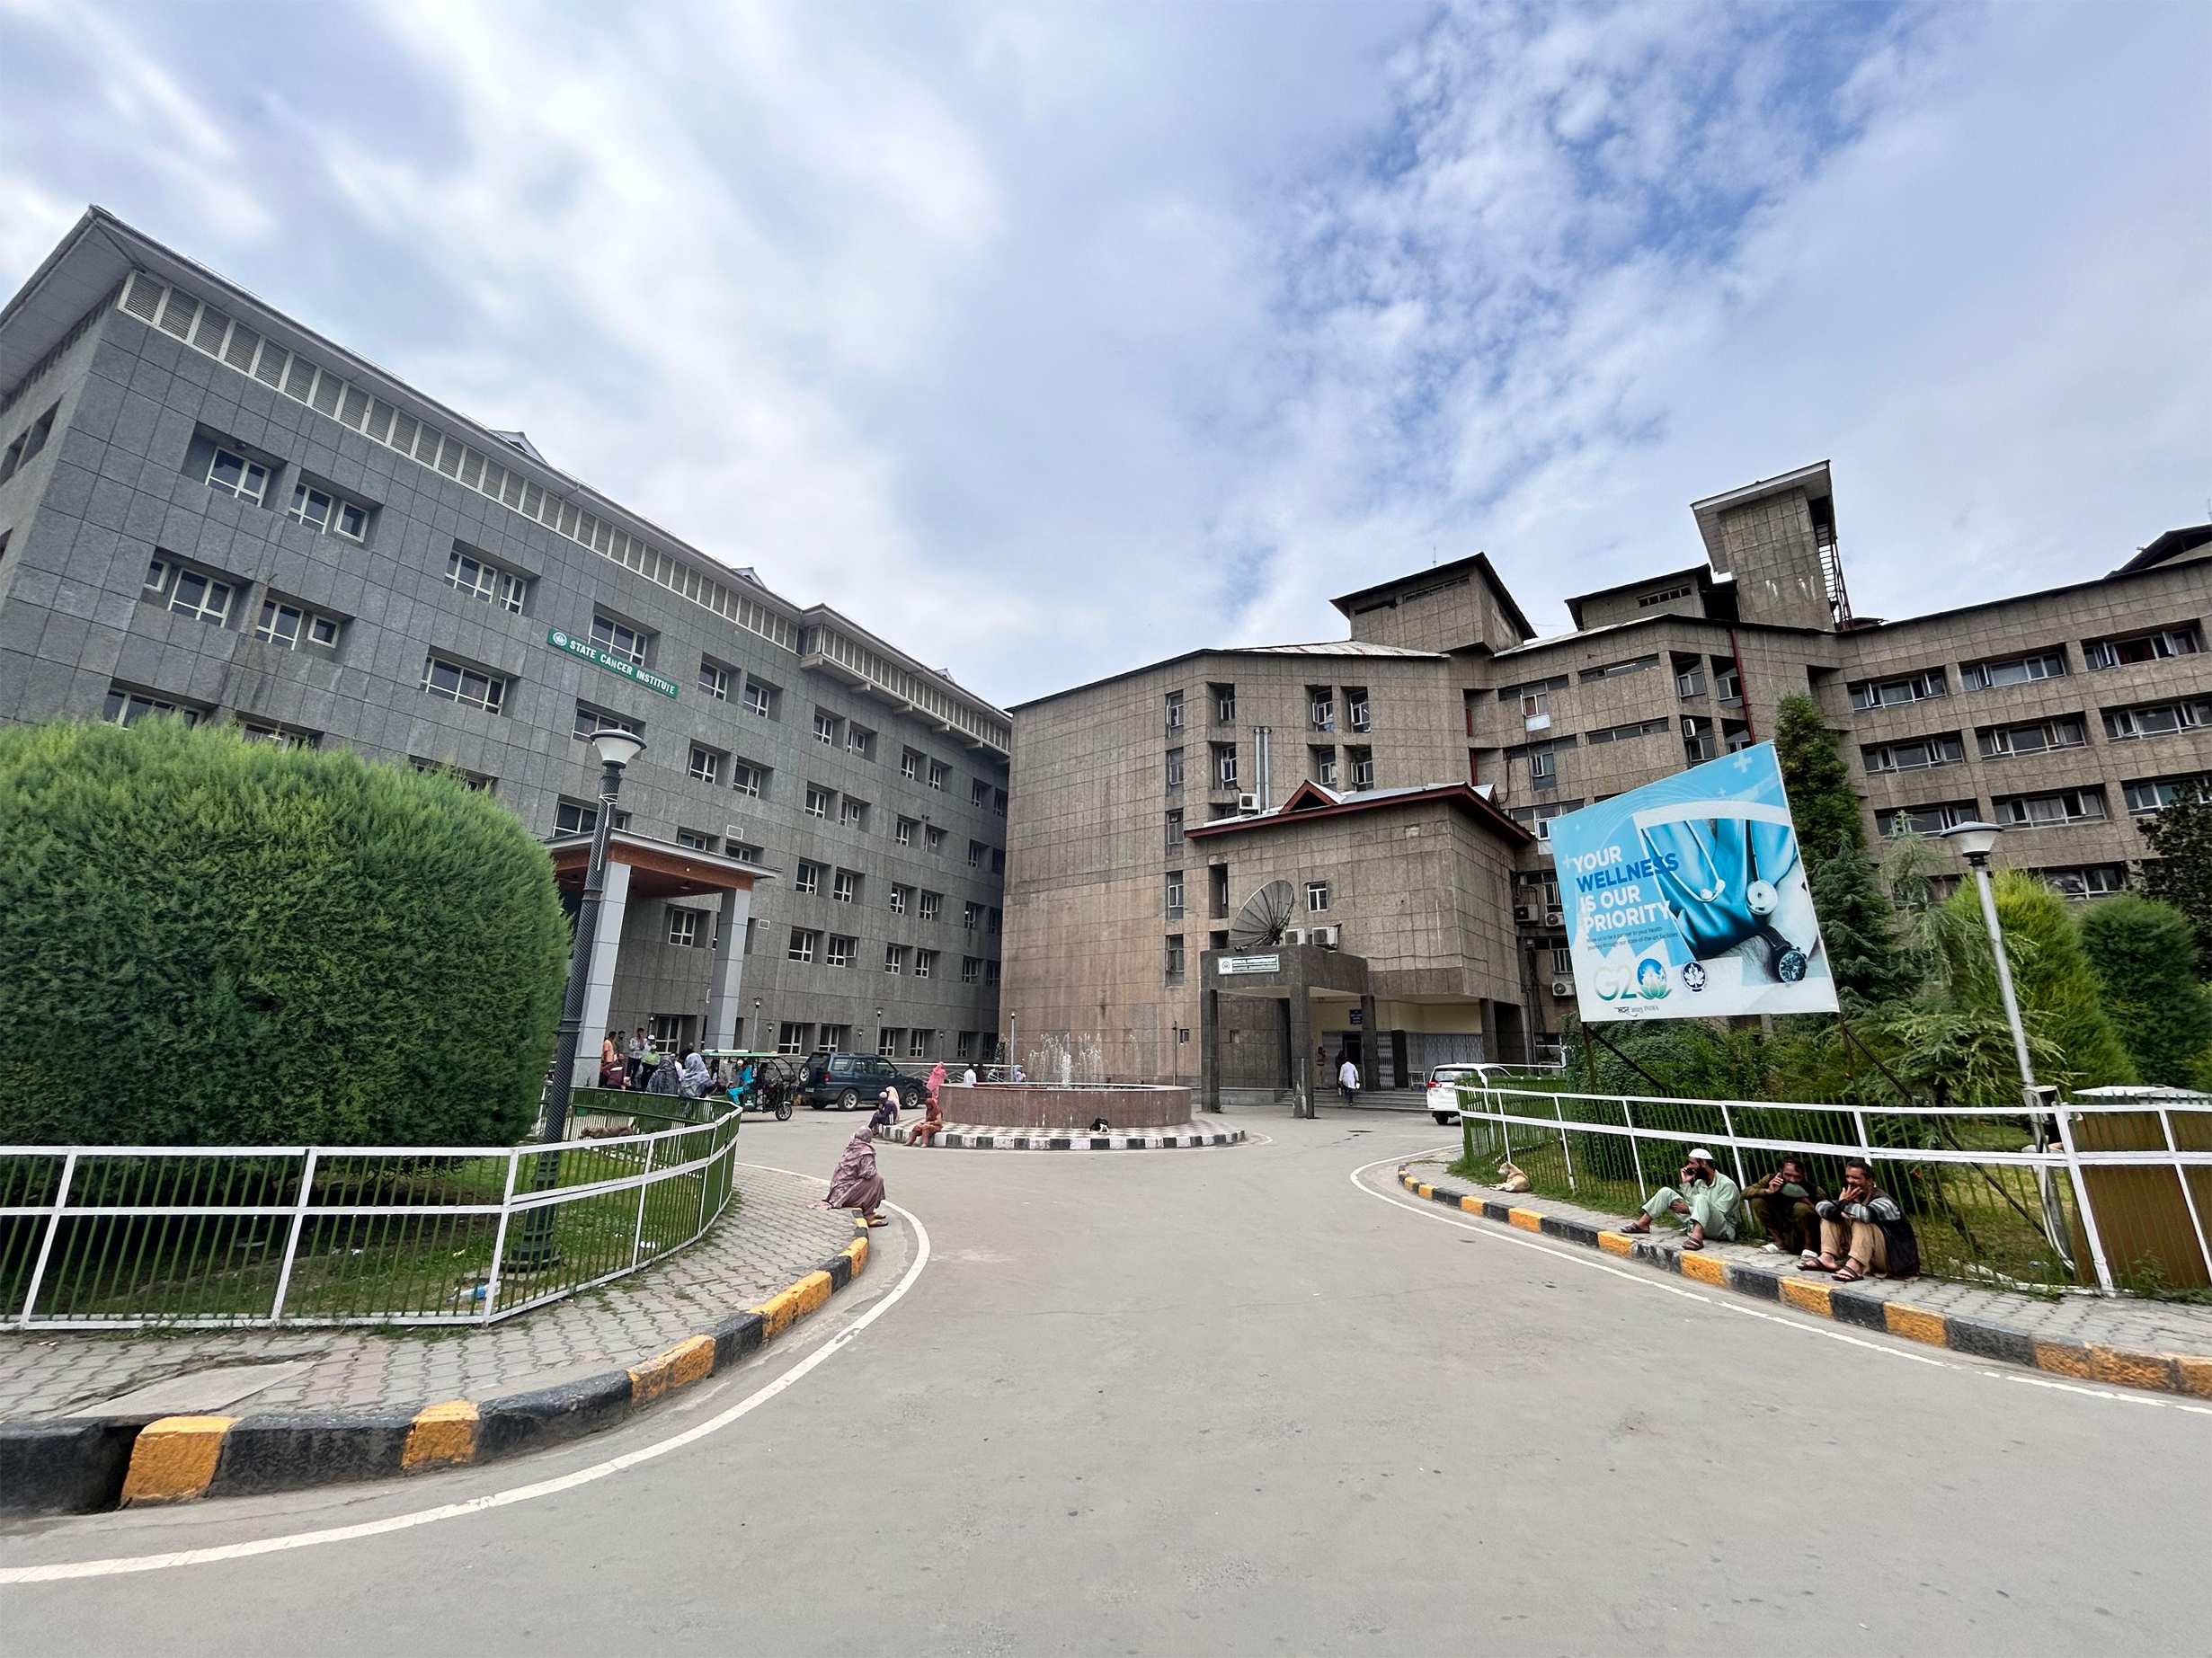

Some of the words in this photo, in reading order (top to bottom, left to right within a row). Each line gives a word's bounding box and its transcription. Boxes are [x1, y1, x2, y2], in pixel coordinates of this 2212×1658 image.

[569, 640, 597, 659] STATE
[600, 653, 633, 676] CANCER
[636, 669, 676, 695] INSTITUTE
[1573, 845, 1623, 873] YOUR
[1576, 853, 1679, 892] WELLNESS
[1580, 895, 1596, 913] IS
[1600, 884, 1642, 909] OUR
[1583, 900, 1671, 933] PRIORITY
